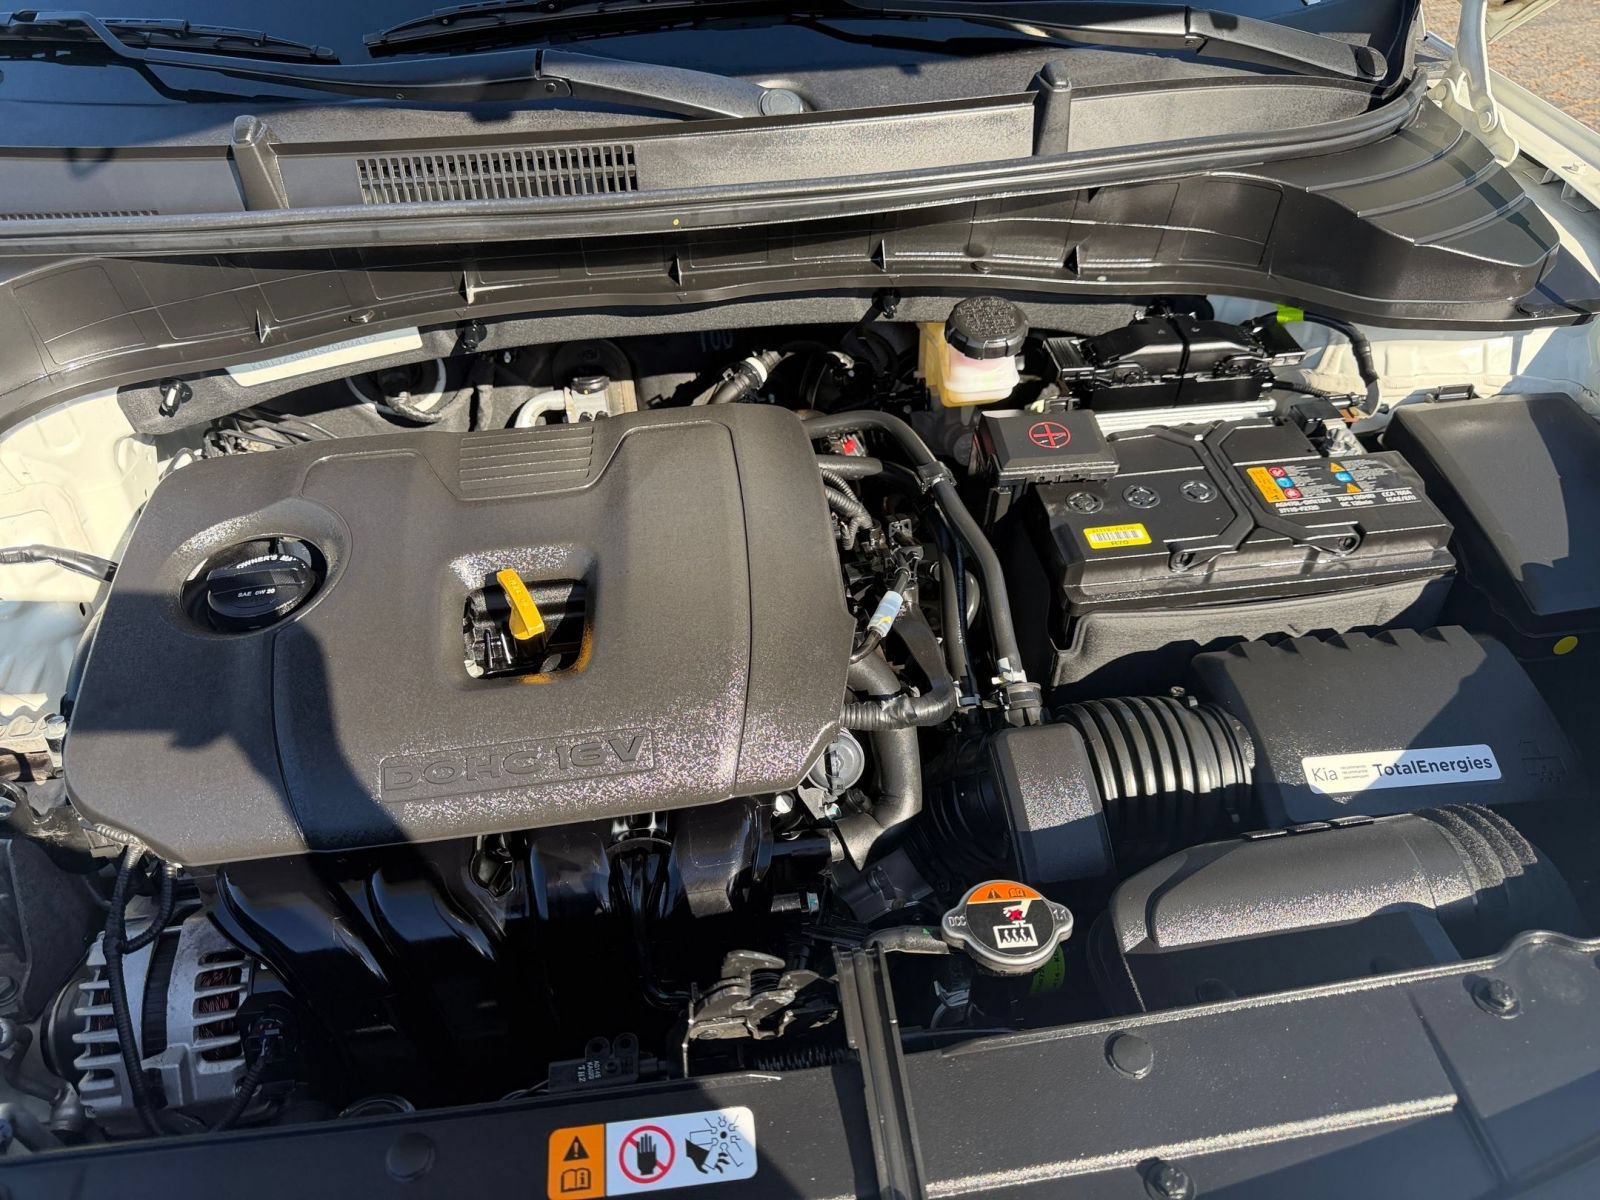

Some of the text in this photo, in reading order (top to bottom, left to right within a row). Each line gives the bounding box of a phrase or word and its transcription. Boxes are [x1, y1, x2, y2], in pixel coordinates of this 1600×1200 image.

[236, 553, 278, 569] OWNER'S
[383, 734, 645, 792] DOHC 16V
[1311, 766, 1338, 782] Kia
[1371, 754, 1493, 778] TotalEnergies
[948, 915, 967, 927] DCC
